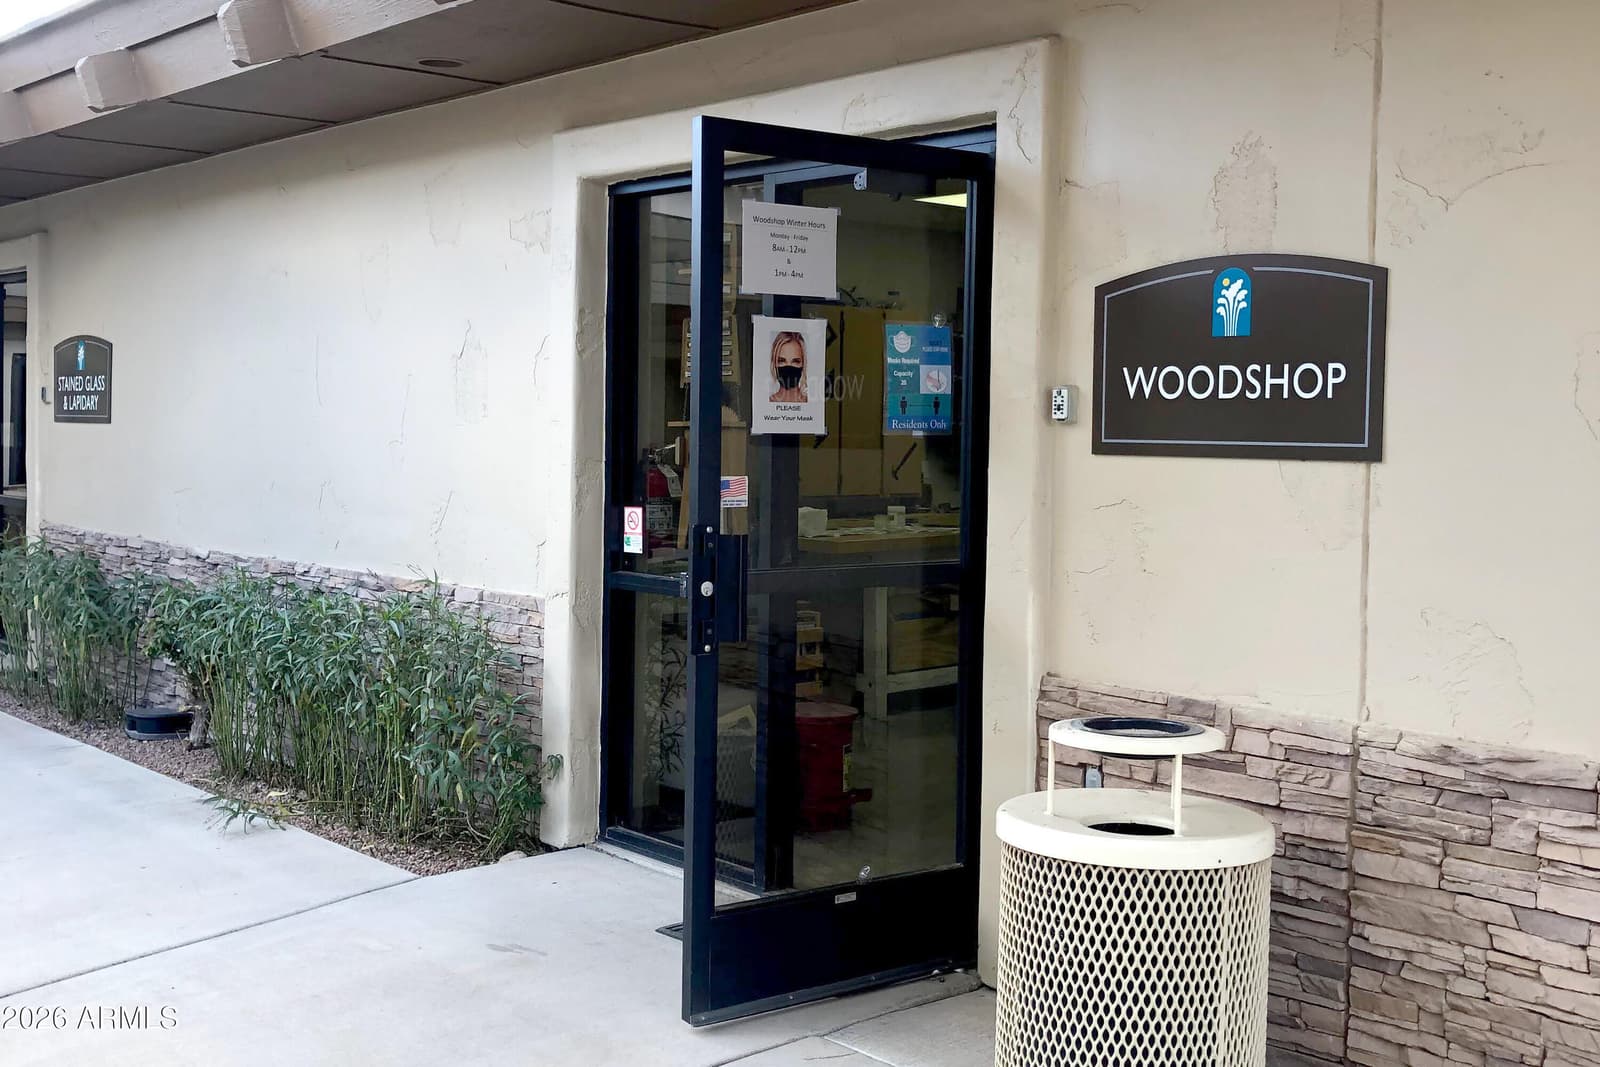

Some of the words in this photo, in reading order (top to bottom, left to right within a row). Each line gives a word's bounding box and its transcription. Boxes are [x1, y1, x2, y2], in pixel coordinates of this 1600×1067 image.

[752, 215, 786, 226] Woodshop
[786, 218, 807, 227] Winter
[807, 220, 826, 229] Hours
[770, 231, 790, 241] Monday
[893, 370, 913, 378] Capacity
[1122, 362, 1347, 400] WOODSHOP
[58, 375, 84, 391] STAINED
[84, 375, 105, 391] GLASS
[63, 395, 68, 410] &
[69, 394, 99, 410] LAPIDARY
[892, 419, 929, 430] Residents
[929, 419, 947, 430] Only
